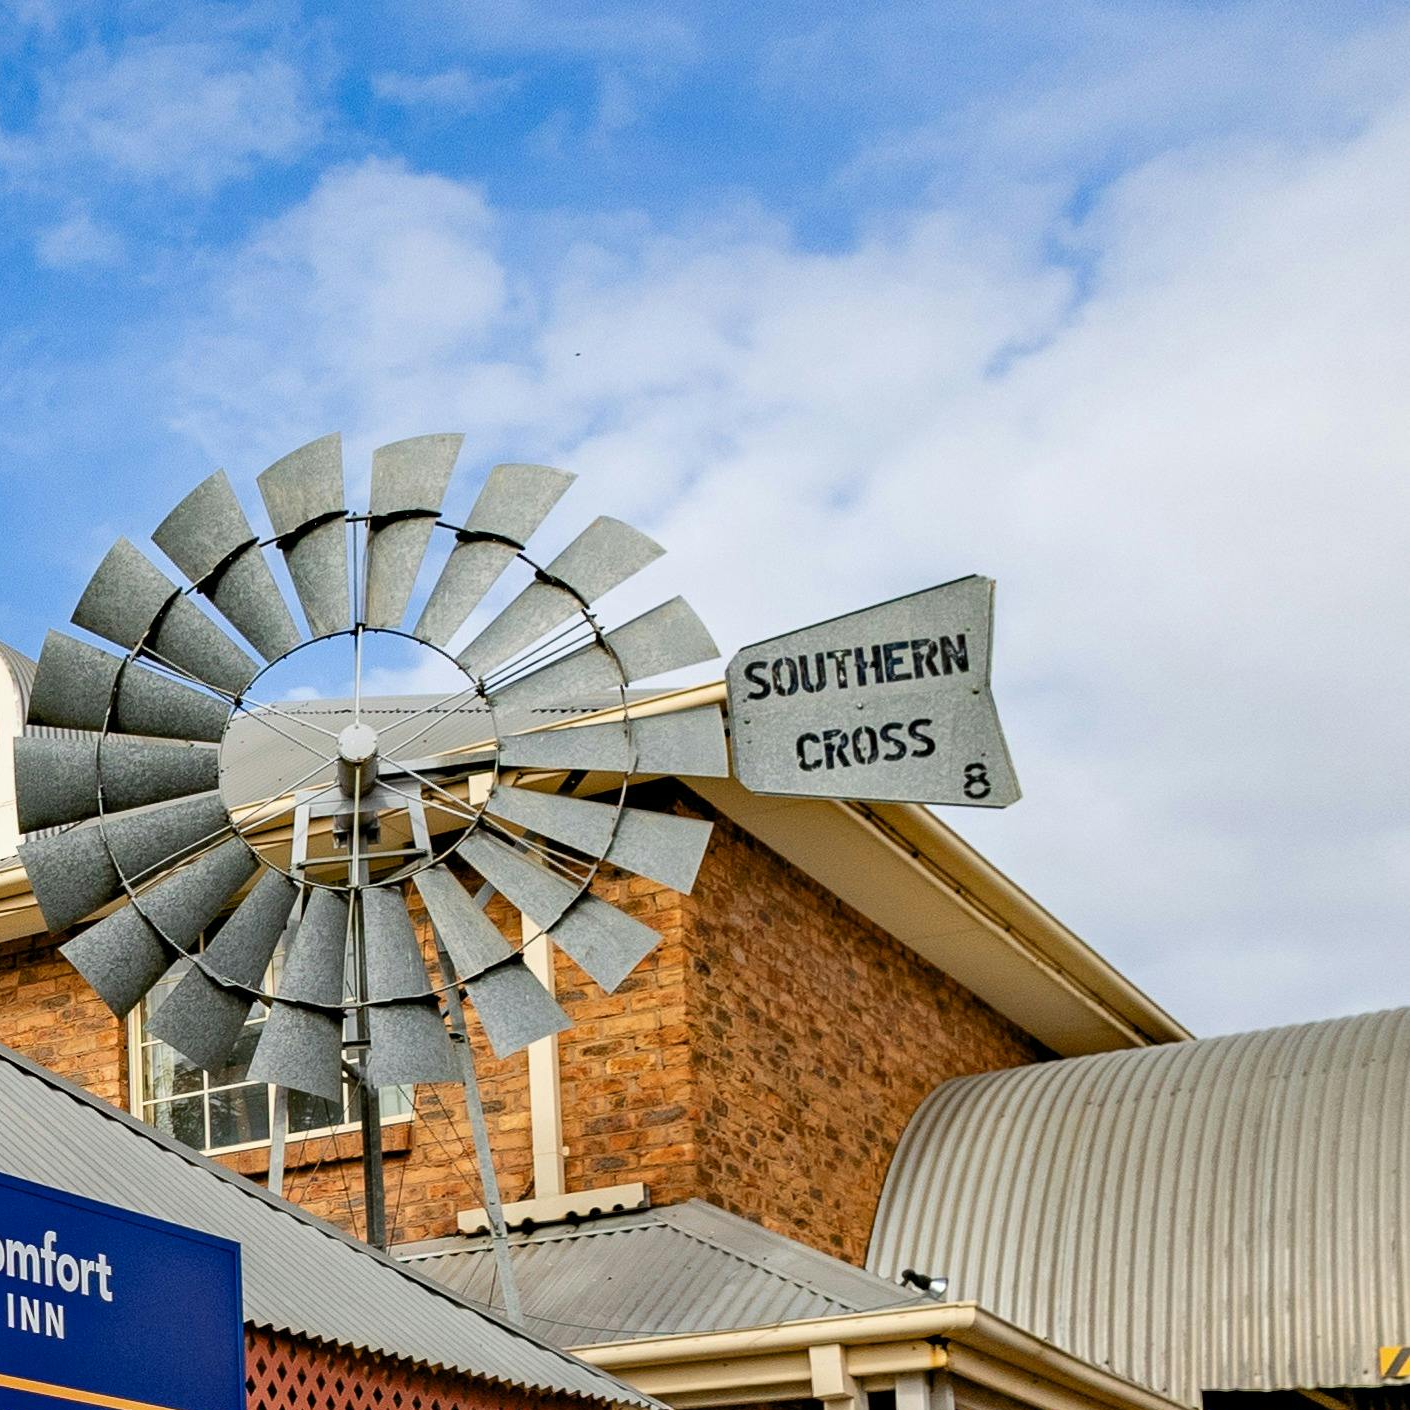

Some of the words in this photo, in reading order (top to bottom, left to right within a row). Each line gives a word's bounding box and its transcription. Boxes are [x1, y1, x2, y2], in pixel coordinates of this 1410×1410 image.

[744, 633, 970, 701] SOUTHERN
[795, 718, 936, 772] CROSS
[963, 762, 991, 800] 8
[7, 1292, 65, 1340] INN
